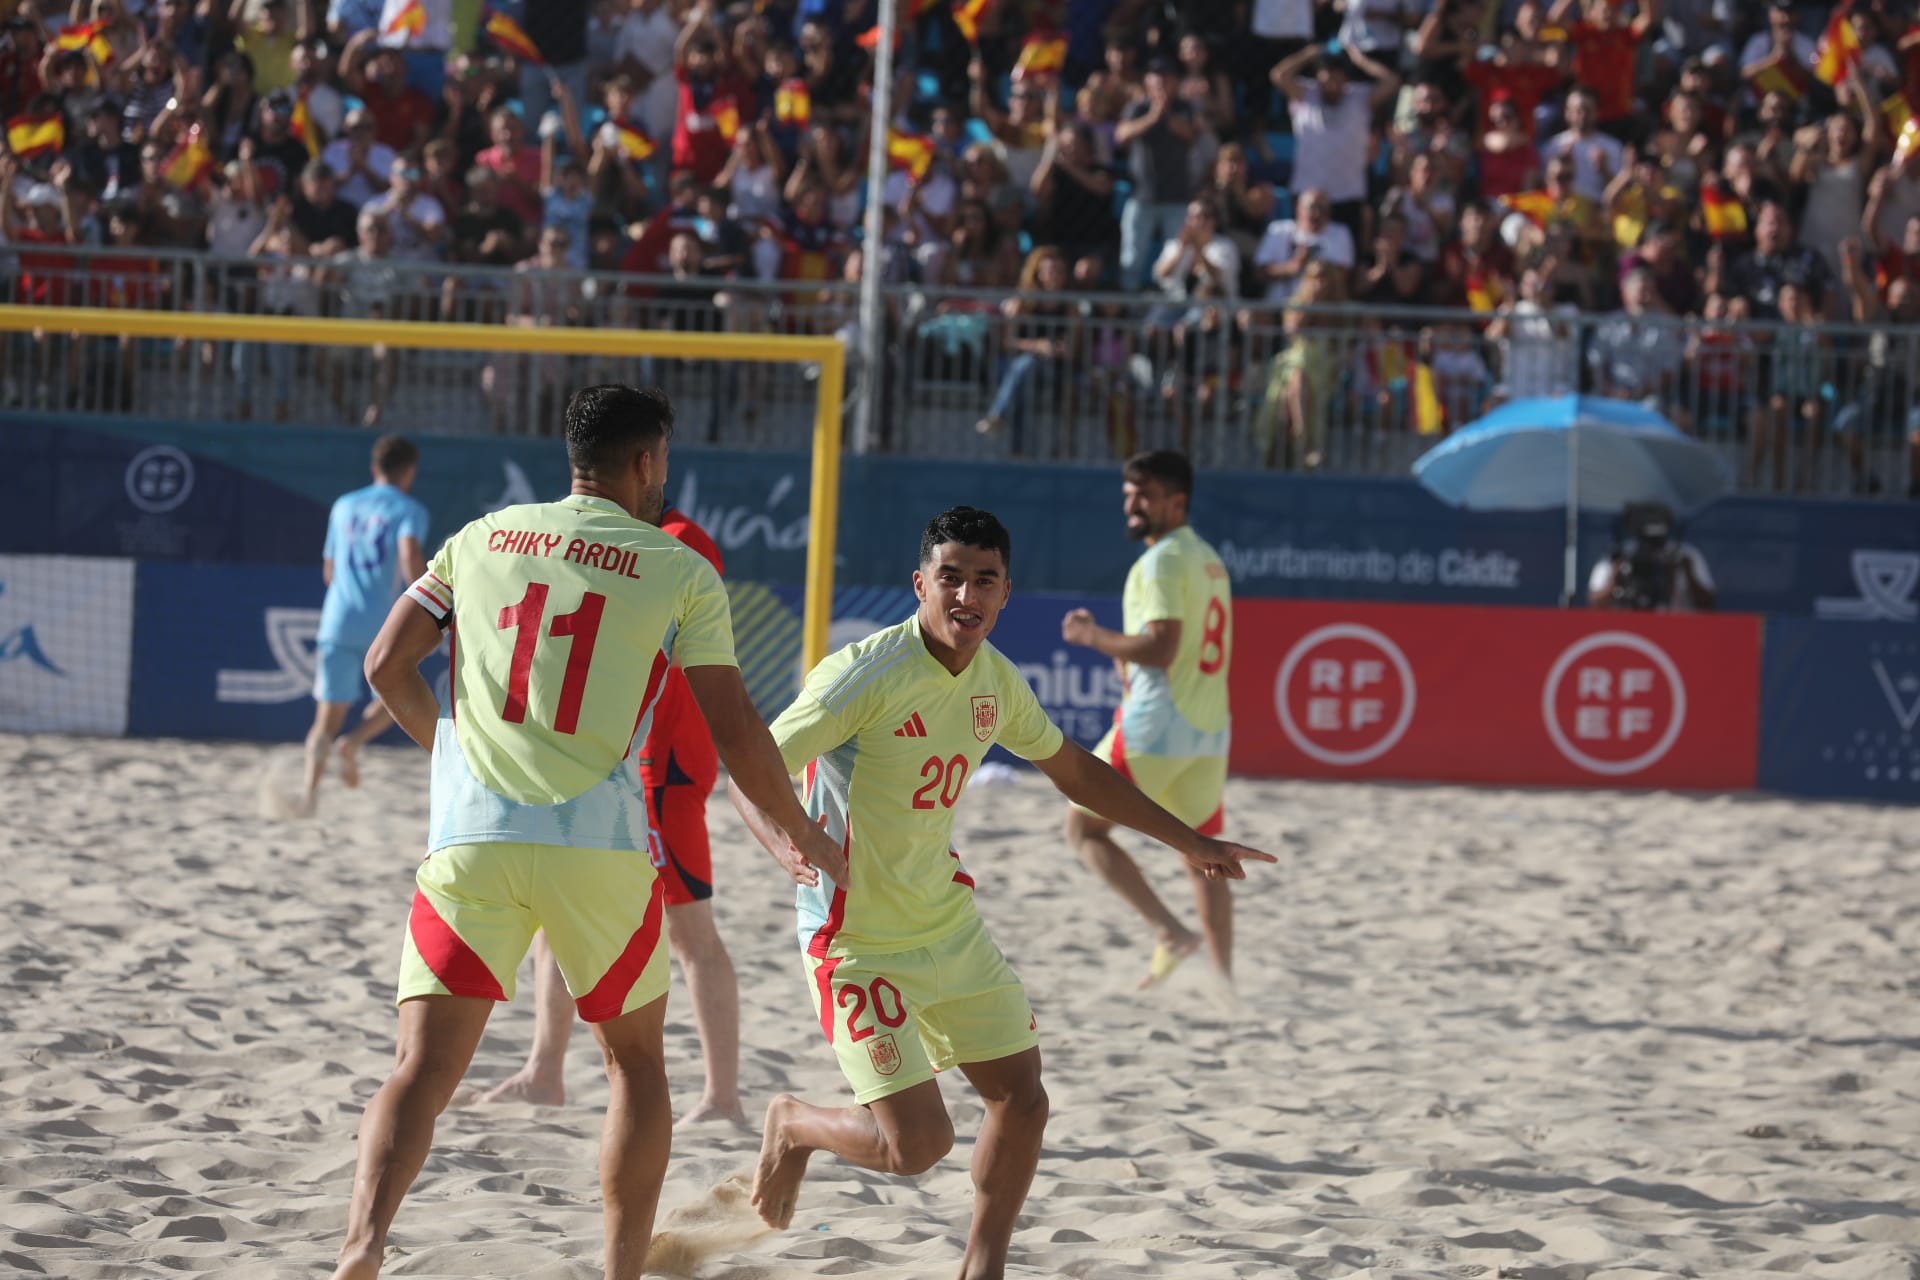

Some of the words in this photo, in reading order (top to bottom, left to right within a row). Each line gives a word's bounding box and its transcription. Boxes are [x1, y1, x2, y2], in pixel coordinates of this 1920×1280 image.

[487, 529, 562, 558] CHIKY
[563, 538, 641, 580] ARDIL
[1220, 540, 1397, 583] Ayuntamiento
[1399, 548, 1435, 585] de
[497, 581, 606, 735] 11
[1198, 595, 1227, 676] 8
[1018, 651, 1122, 708] nius
[1309, 659, 1384, 691] RF
[1577, 667, 1654, 699] RF
[1306, 698, 1383, 731] EF
[1574, 706, 1652, 740] EF
[912, 754, 968, 809] 20
[837, 976, 907, 1043] 20
